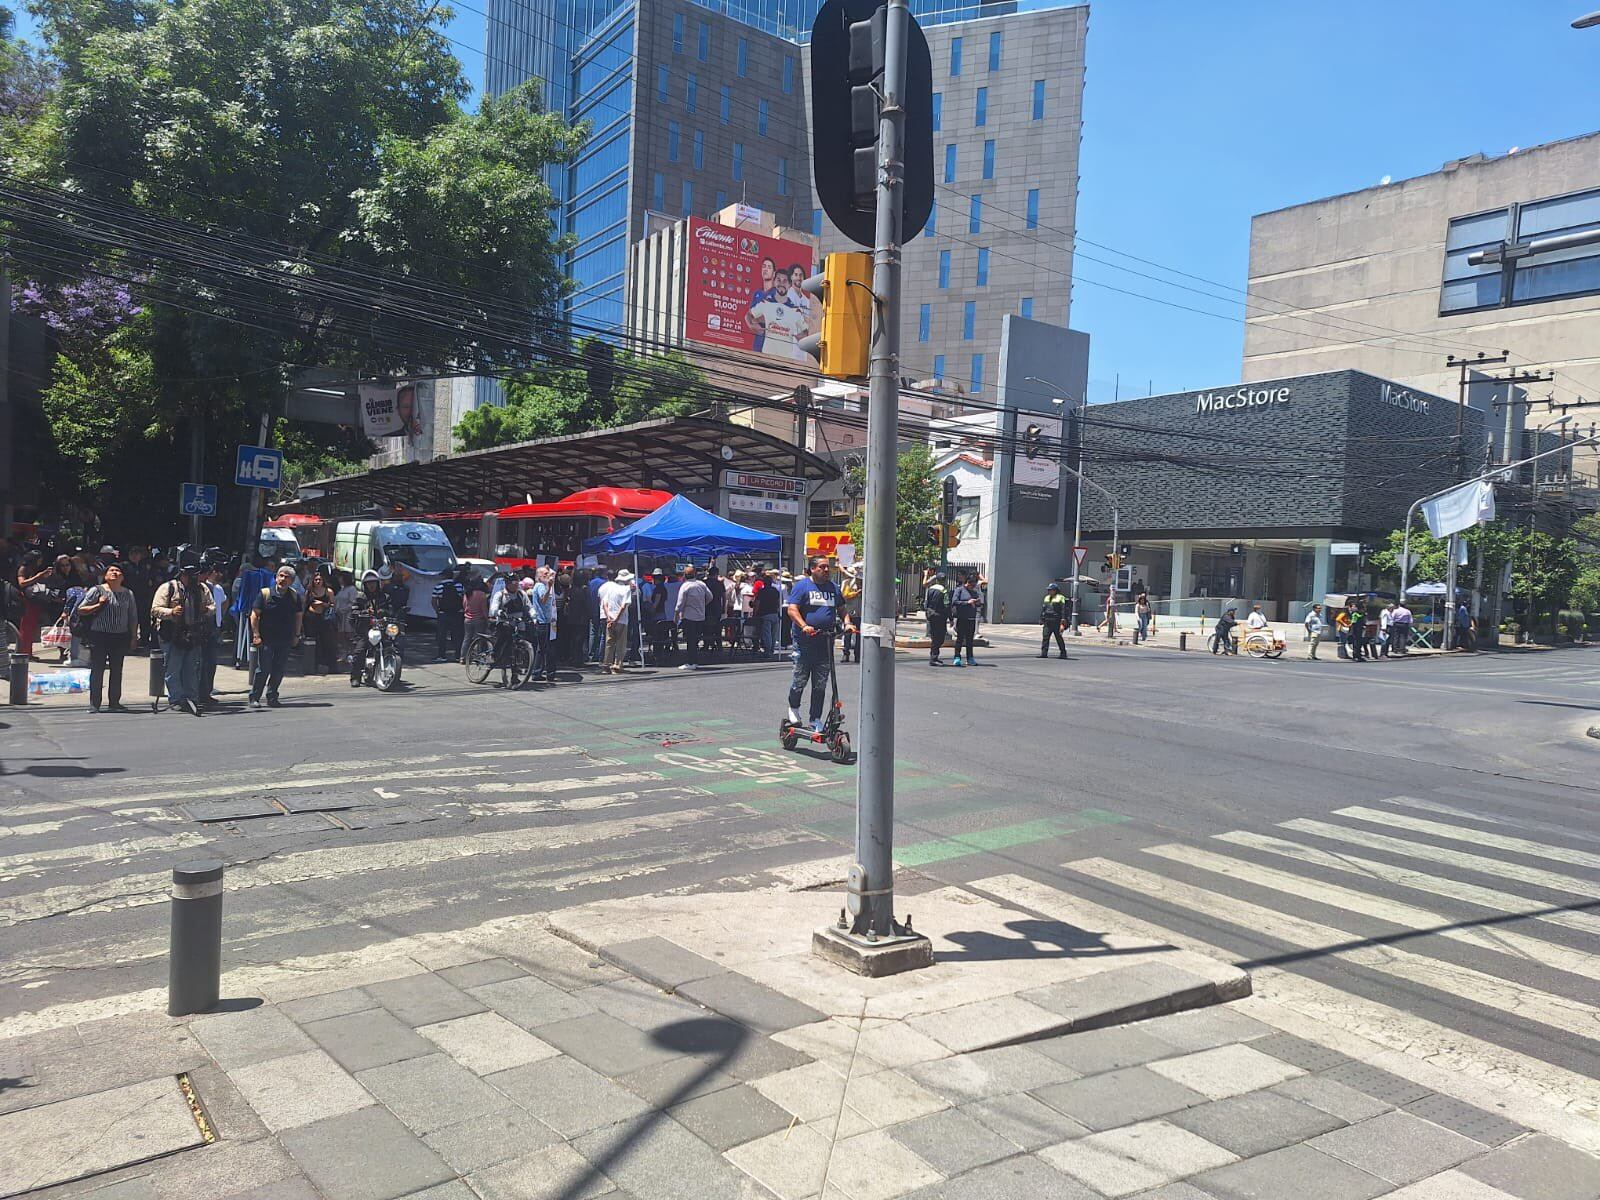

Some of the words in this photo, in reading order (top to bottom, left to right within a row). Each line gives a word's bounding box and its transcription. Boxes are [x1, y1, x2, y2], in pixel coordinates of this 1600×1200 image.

[714, 299, 737, 310] $1,000
[1196, 387, 1290, 412] MacStore
[1380, 383, 1430, 415] MacStore
[367, 406, 394, 416] VIENE
[195, 486, 205, 497] E
